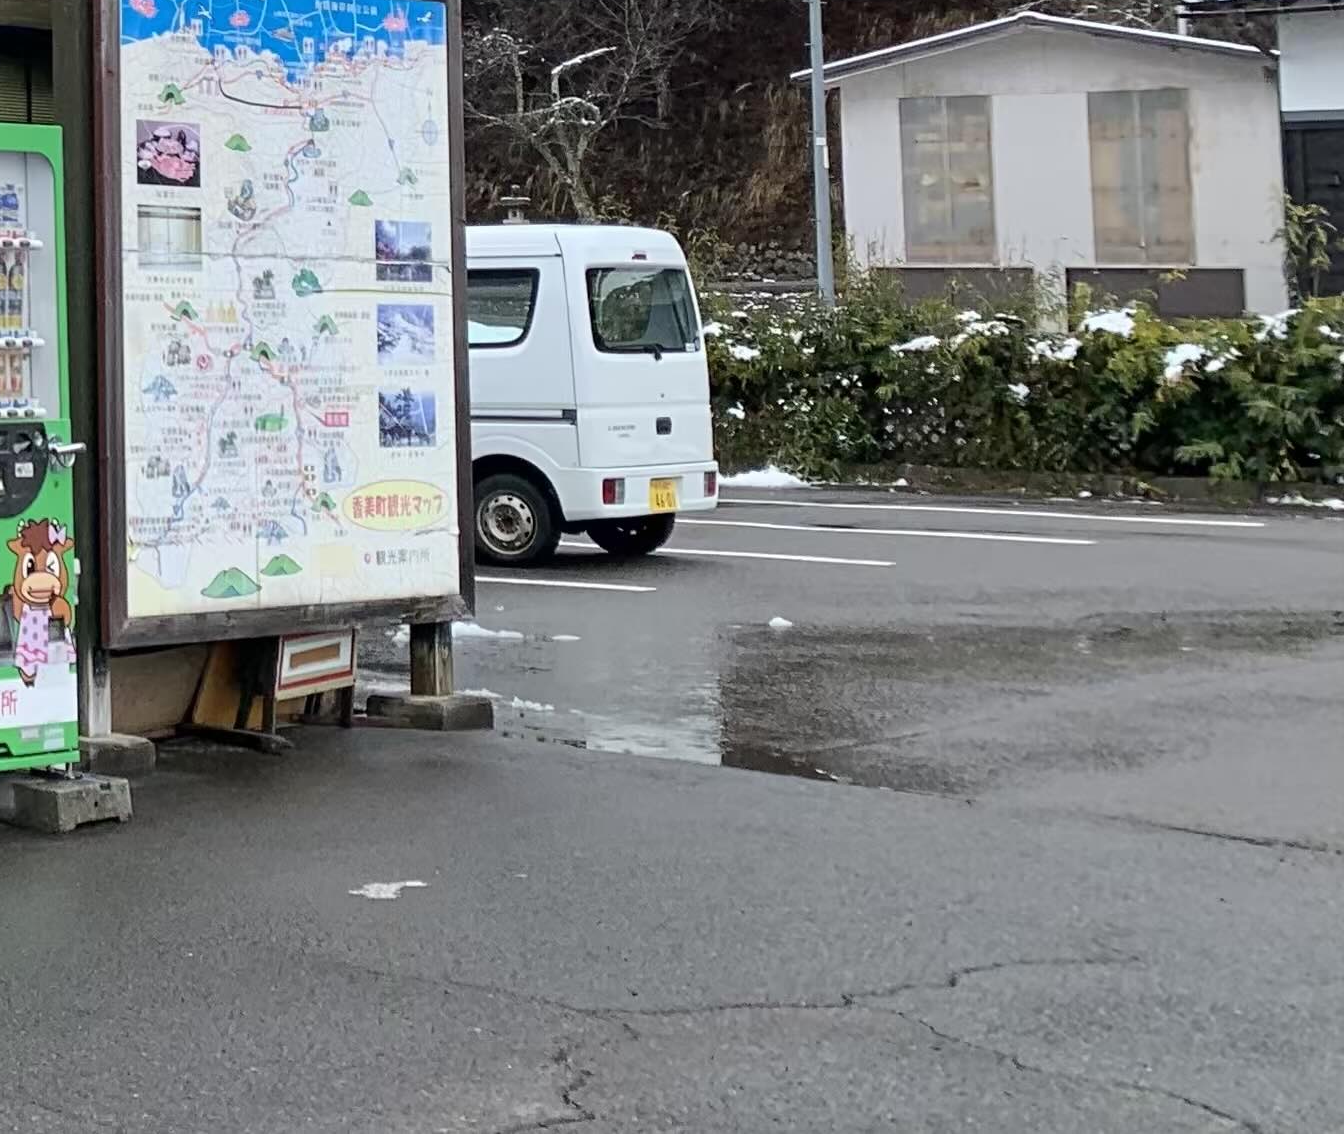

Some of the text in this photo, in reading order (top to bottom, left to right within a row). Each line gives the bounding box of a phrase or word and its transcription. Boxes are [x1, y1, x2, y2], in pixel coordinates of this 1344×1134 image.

[376, 547, 431, 566] 観光案内所
